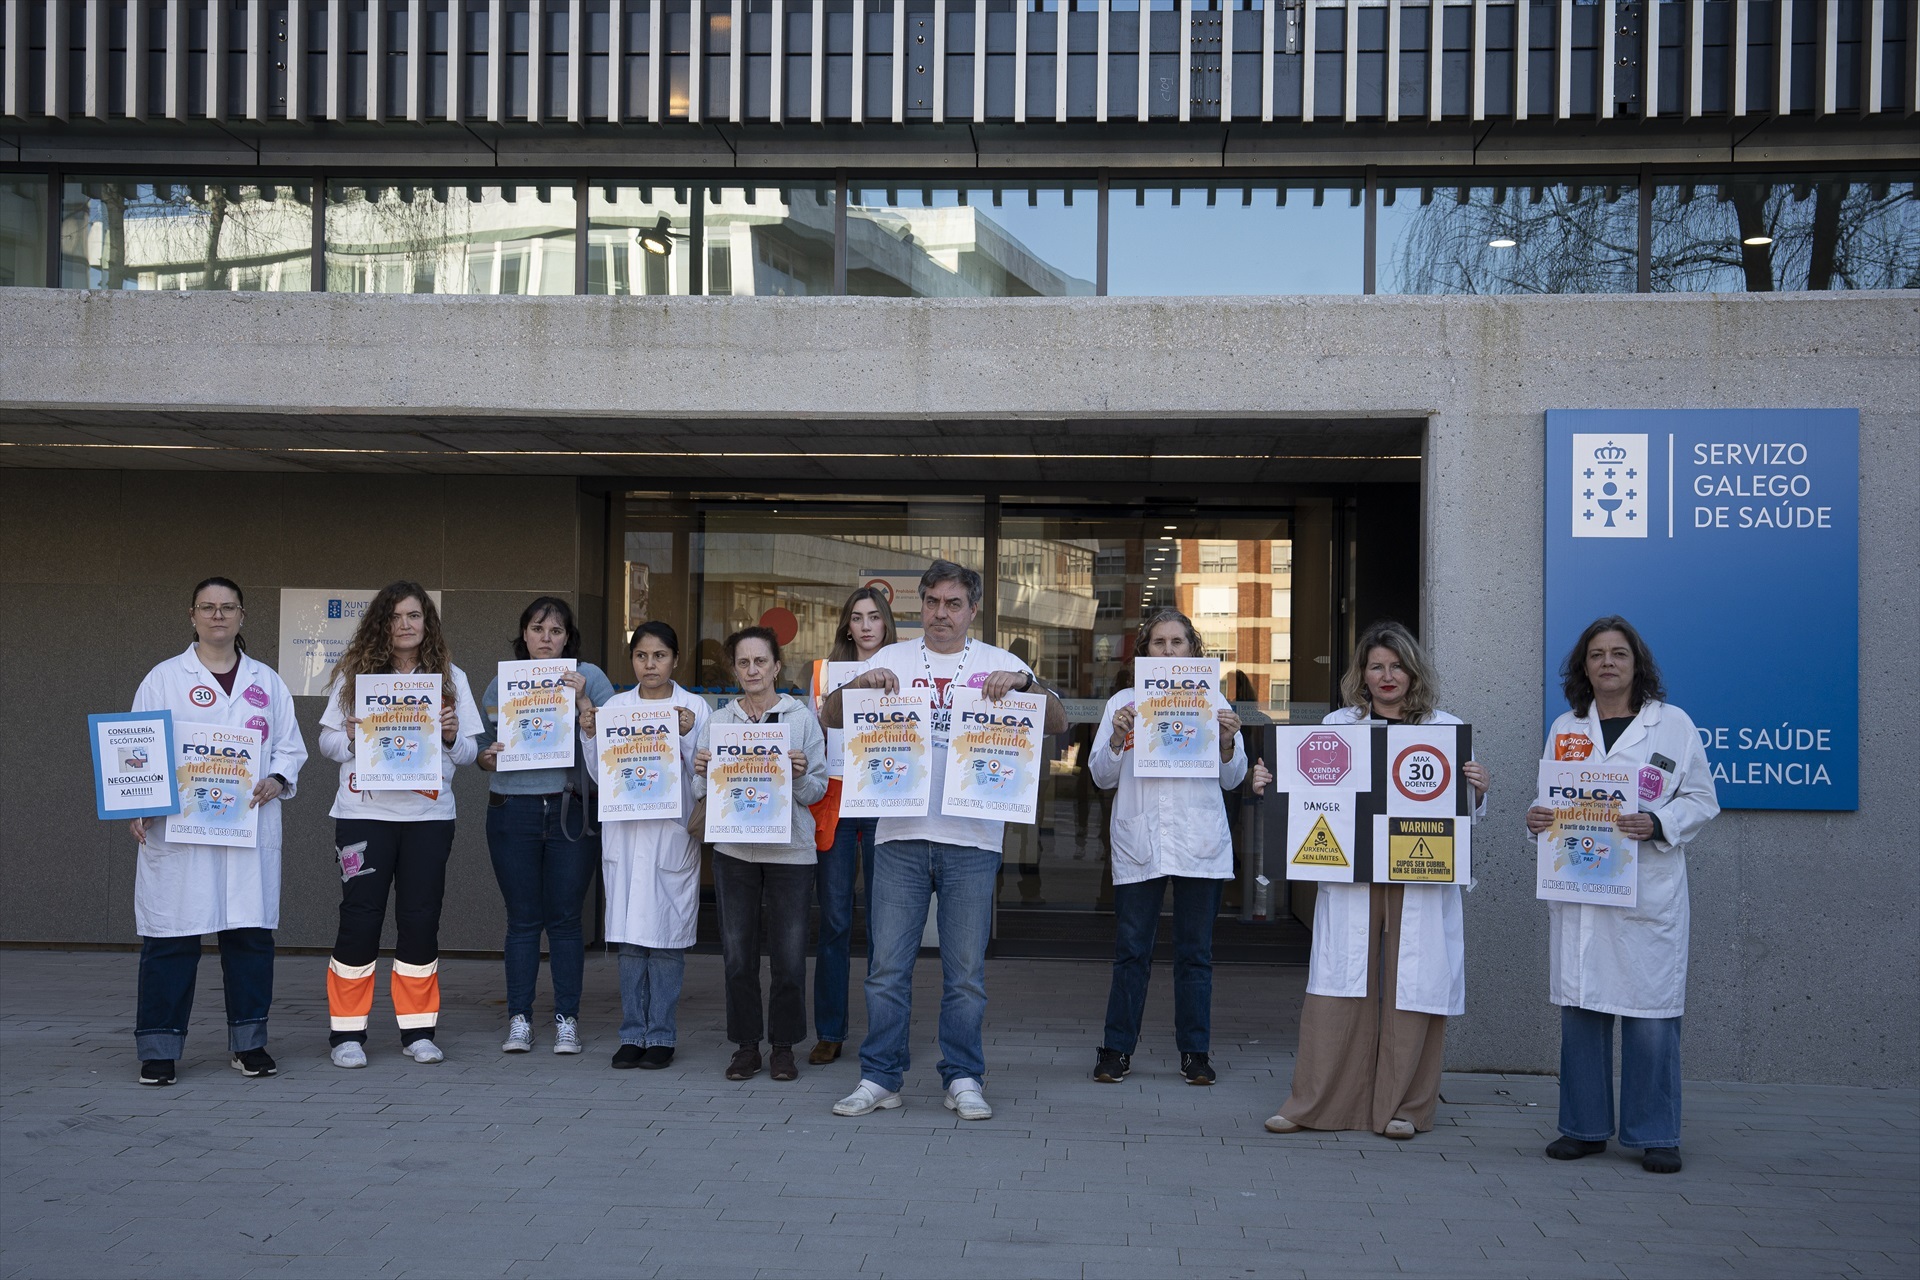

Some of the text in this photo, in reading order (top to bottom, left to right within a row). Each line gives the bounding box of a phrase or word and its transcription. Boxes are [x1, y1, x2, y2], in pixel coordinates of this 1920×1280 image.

[1694, 443, 1807, 464] SERVIZO
[1694, 475, 1810, 496] GALEGO
[1695, 500, 1832, 529] DE SAÚDE
[508, 678, 567, 690] FOLGA
[1145, 679, 1210, 689] FOLGA
[195, 691, 211, 700] 30
[366, 695, 433, 705] FOLGA
[513, 694, 562, 707] indefinida
[1150, 697, 1205, 708] indefinida
[372, 712, 427, 723] indefinida
[854, 711, 921, 723] FOLGA
[962, 712, 1034, 728] FOLGA
[606, 724, 670, 737] FOLGA
[861, 730, 915, 743] indefinida
[1696, 722, 1831, 750] DE SAÚDE
[966, 731, 1026, 748] indefinida
[1309, 741, 1338, 751] STOP
[1560, 738, 1591, 746] MDICOS
[183, 743, 251, 759] FOLGA
[613, 742, 666, 755] indefinida
[717, 745, 782, 755] FOLGA
[188, 762, 245, 777] indefinida
[723, 762, 777, 774] indefinida
[1409, 764, 1434, 780] 30
[1708, 762, 1832, 786] ALENCIA
[108, 773, 163, 784] NEGOCIACIÓN
[1642, 771, 1660, 781] STOP
[1549, 786, 1626, 802] FOLGA
[1304, 802, 1340, 812] DANGER
[1400, 821, 1444, 834] WARNING
[1316, 853, 1339, 861] LÍMITES
[1542, 879, 1631, 896] A NOSA VOZ, O NOSO FUTURO
